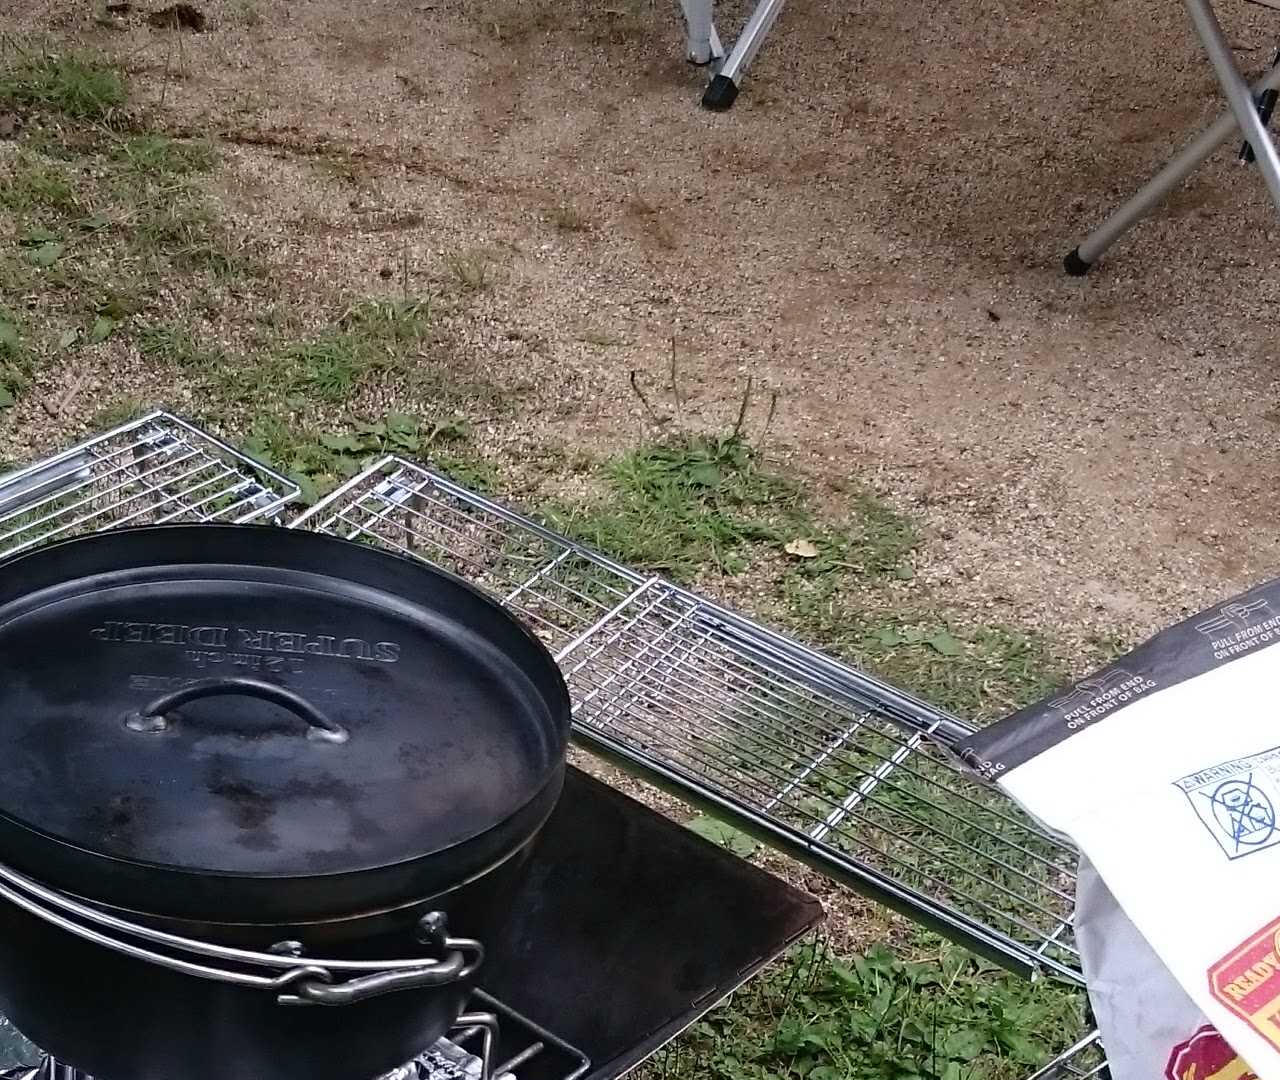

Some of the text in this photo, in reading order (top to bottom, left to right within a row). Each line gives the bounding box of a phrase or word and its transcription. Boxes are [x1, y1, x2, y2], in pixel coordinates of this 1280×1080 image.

[88, 621, 401, 663] SUPER DEEP
[1211, 636, 1235, 651] PULL
[1235, 624, 1264, 642] FROM
[1214, 648, 1231, 660] ON
[1230, 635, 1260, 655] FRONT
[1260, 629, 1275, 642] OF
[1063, 675, 1144, 722] PULL FROM END
[1067, 678, 1157, 730] ON FRONT OF BAG
[1193, 760, 1253, 786] WARNING
